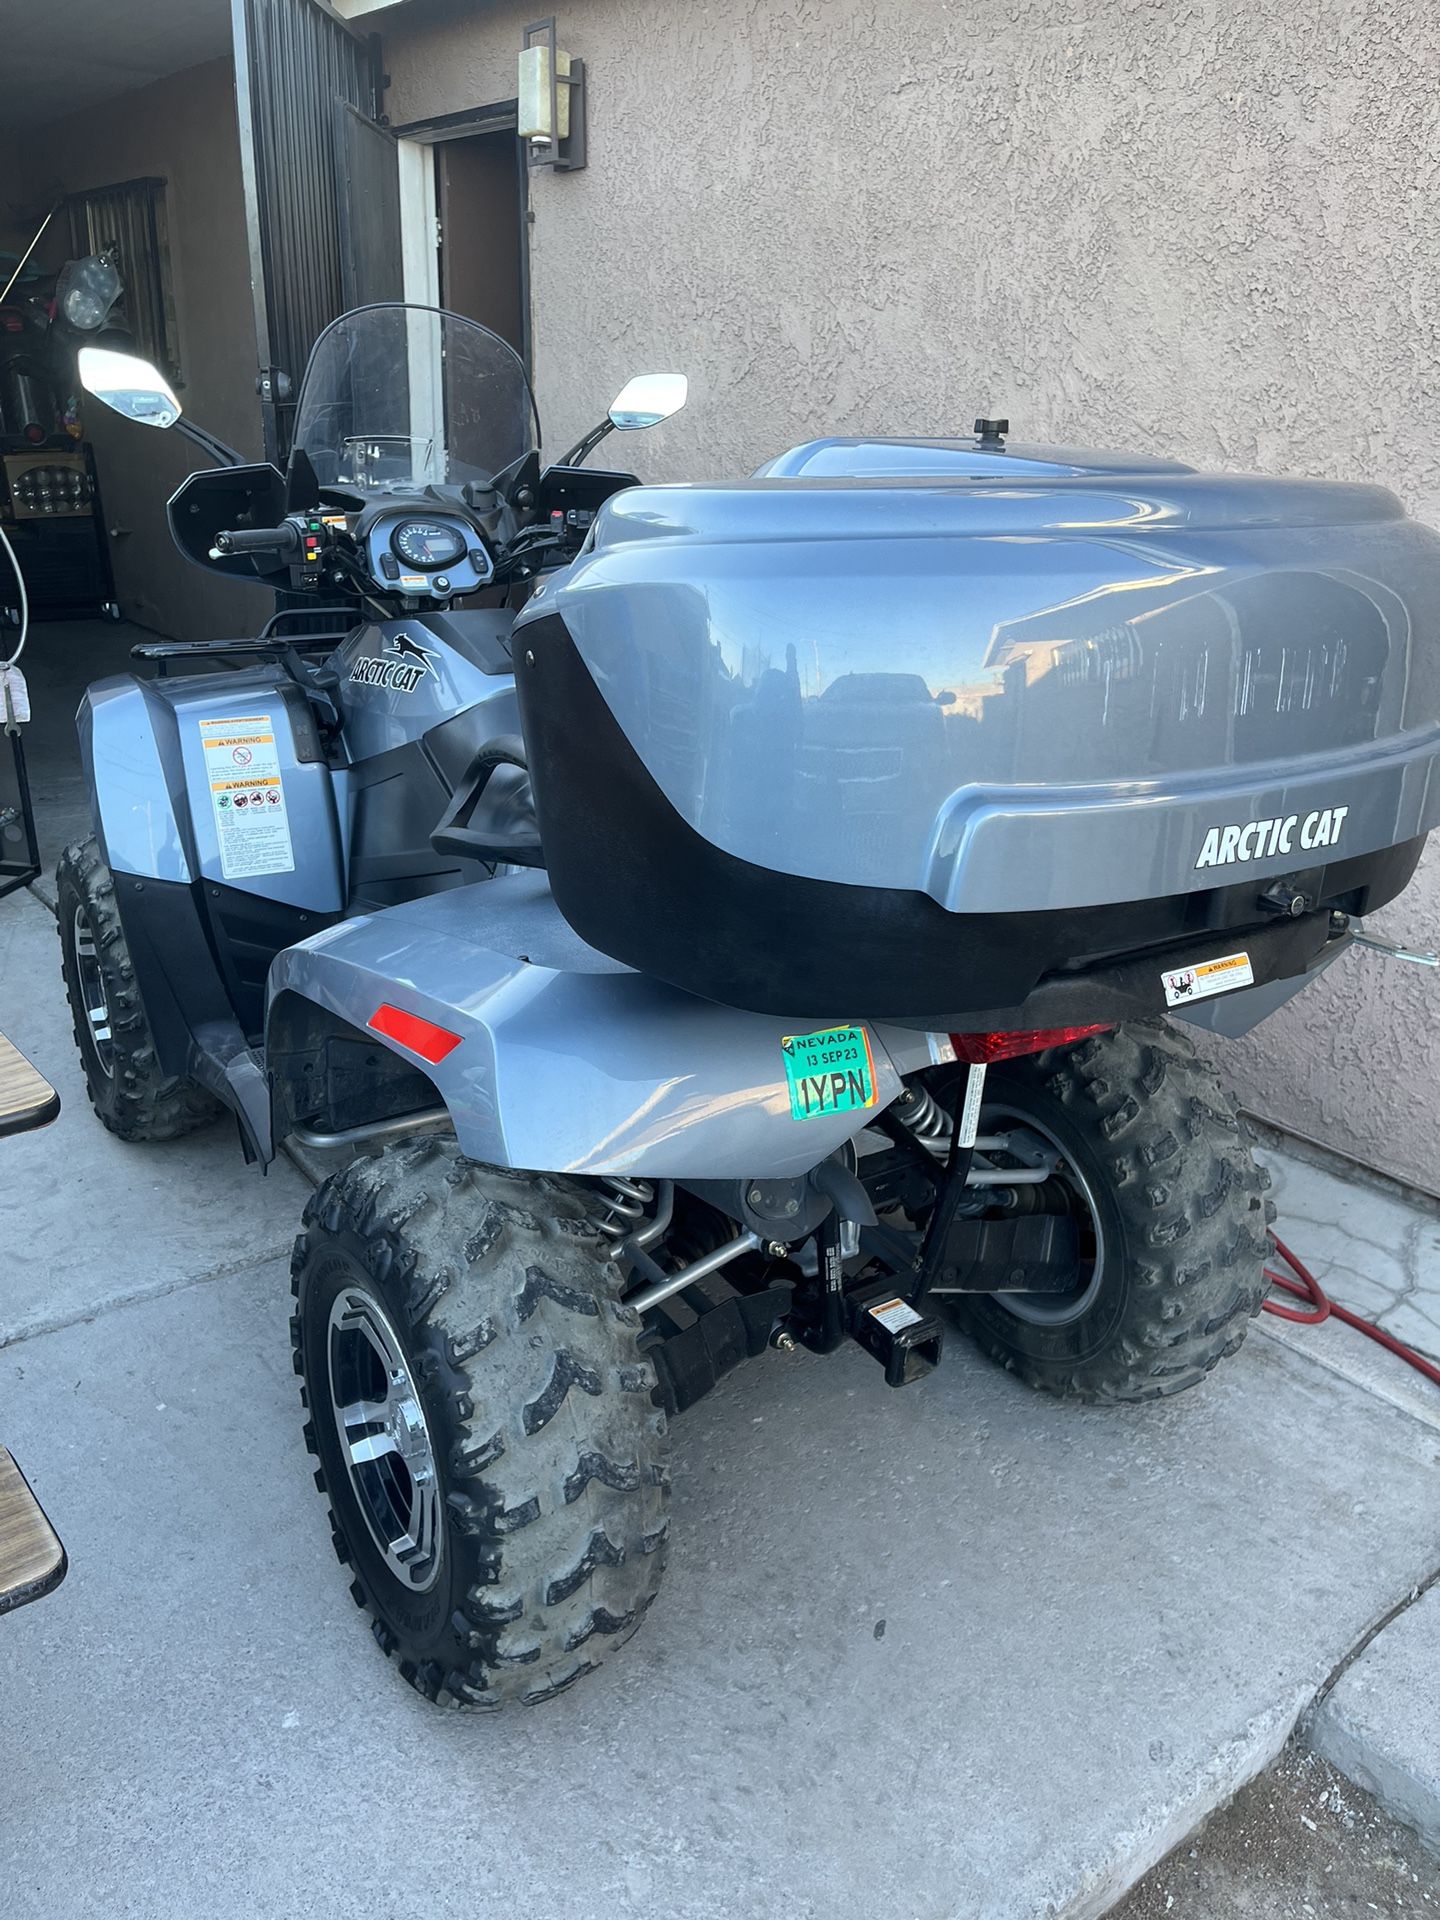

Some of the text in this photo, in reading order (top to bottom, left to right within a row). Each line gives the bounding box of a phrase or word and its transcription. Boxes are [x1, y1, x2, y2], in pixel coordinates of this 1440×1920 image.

[349, 657, 427, 693] ARCTIC CAT
[225, 736, 261, 746] WARNING
[232, 779, 269, 789] WARNING
[1194, 805, 1349, 869] ARCTIC CAT
[797, 1031, 858, 1050] NEVADA
[806, 1055, 818, 1067] 13
[801, 1068, 866, 1114] 1YPN
